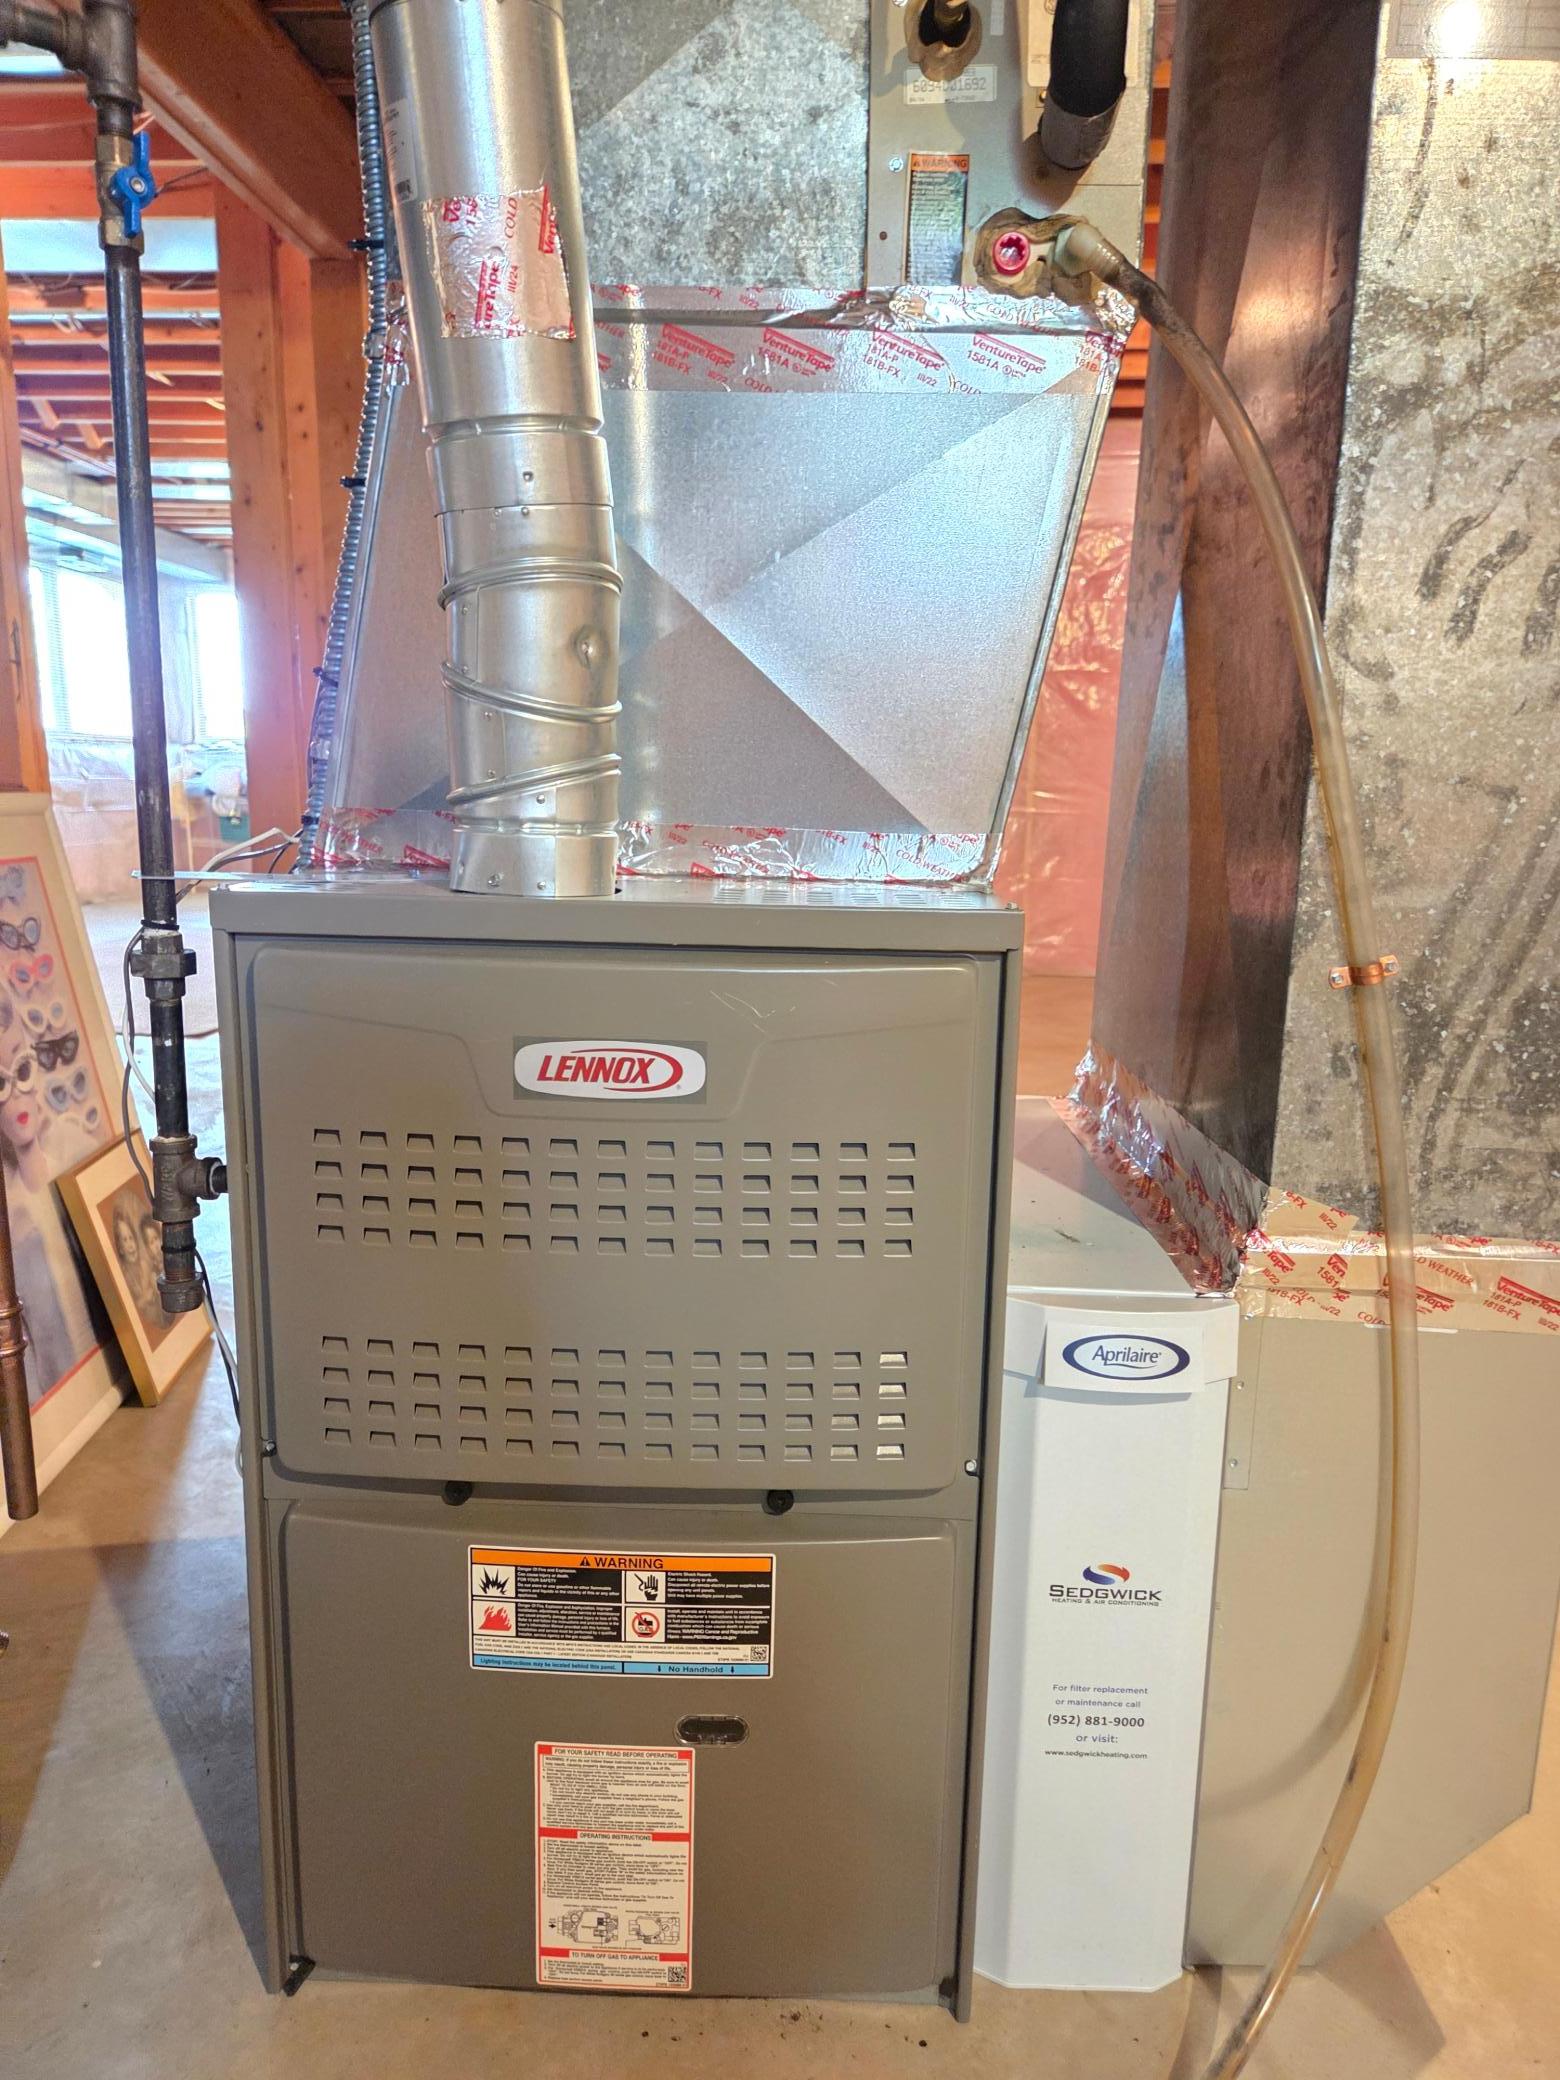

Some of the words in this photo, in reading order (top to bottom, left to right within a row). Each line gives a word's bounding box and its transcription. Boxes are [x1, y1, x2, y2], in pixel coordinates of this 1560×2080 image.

[504, 197, 519, 239] COLD
[763, 332, 834, 372] VentureTape
[872, 332, 942, 372] VentureTape
[966, 350, 999, 371] 1581A
[972, 336, 1045, 375] VentureTape
[862, 354, 901, 377] 181B-FX
[537, 1055, 655, 1084] LENNOX
[1428, 1261, 1475, 1288] WEATHER
[1092, 1345, 1159, 1366] Aprilaire
[594, 1557, 663, 1570] WARNING
[1049, 1585, 1163, 1601] SEDGWICK
[1053, 1684, 1067, 1692] For
[1070, 1685, 1091, 1693] filter
[1093, 1686, 1148, 1695] replacement
[1067, 1699, 1123, 1708] maintenance
[1126, 1700, 1141, 1708] call
[1048, 1714, 1080, 1727] (952)
[1085, 1716, 1145, 1727] 881-9000
[1092, 1734, 1119, 1744] visit:
[1045, 1750, 1148, 1760] www.sedgwickheating.com
[612, 1833, 651, 1841] INSTRUCTIONS
